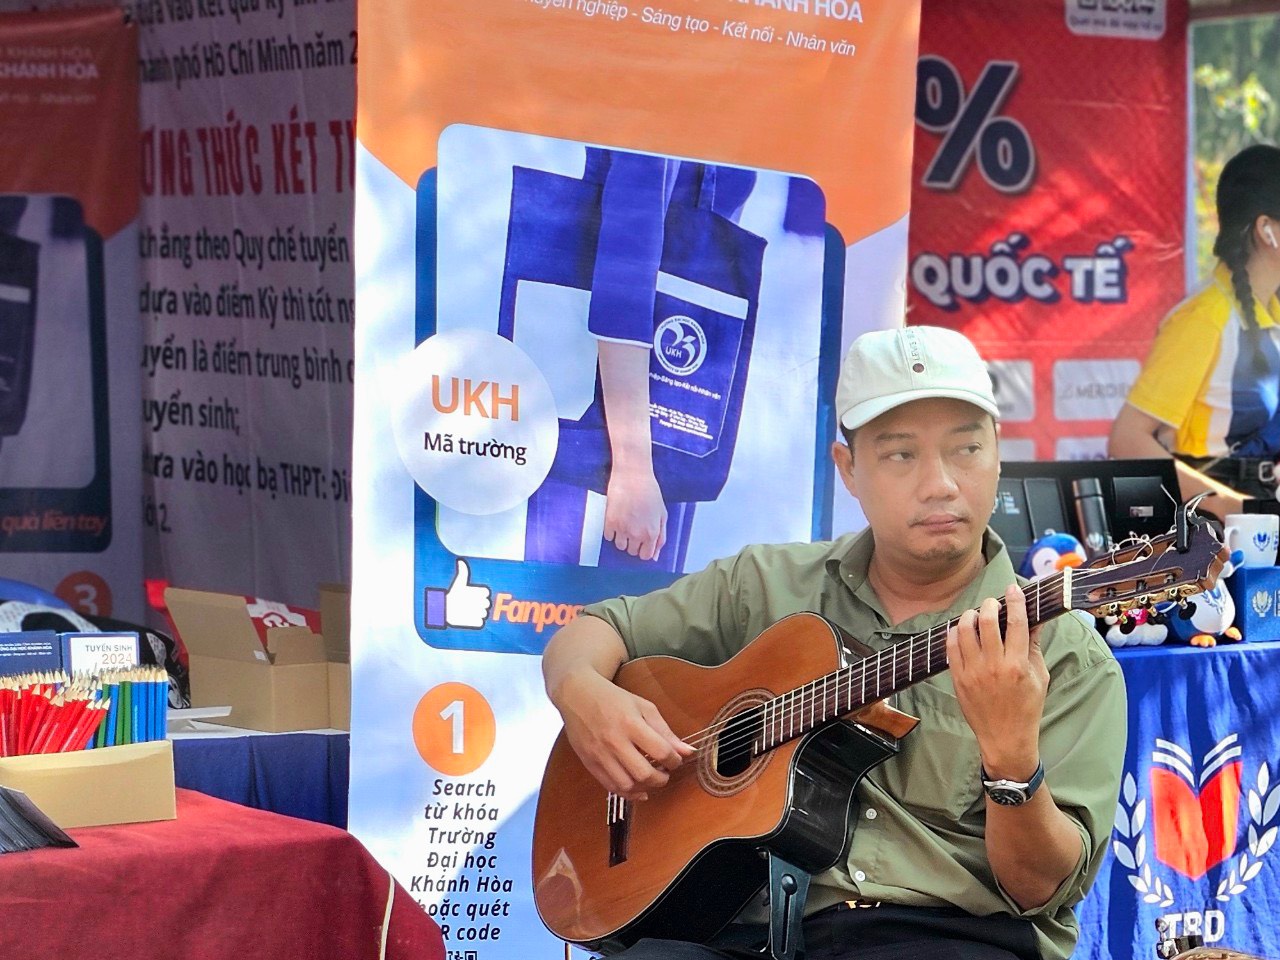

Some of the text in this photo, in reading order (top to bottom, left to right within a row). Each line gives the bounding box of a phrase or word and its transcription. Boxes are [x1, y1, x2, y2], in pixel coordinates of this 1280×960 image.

[576, 0, 628, 21] nghiệp
[641, 6, 681, 31] Sáng
[685, 16, 709, 33] tạo
[722, 19, 747, 39] Kết
[750, 25, 774, 43] nối
[786, 31, 826, 51] Nhân
[829, 40, 857, 57] văn
[204, 42, 226, 78] Hồ
[229, 38, 254, 75] Chí
[257, 34, 303, 73] Minh
[305, 31, 345, 69] năm
[196, 108, 263, 196] THỨC
[271, 104, 317, 195] KẾT
[195, 227, 231, 261] theo
[233, 228, 264, 271] Quy
[267, 225, 297, 262] chế
[300, 222, 350, 273] tuyển
[912, 232, 1135, 309] QUỐC TẾ
[182, 283, 212, 316] vào
[216, 280, 255, 319] điểm
[258, 285, 279, 329] Kỳ
[283, 287, 306, 321] thi
[308, 287, 335, 323] tốt
[192, 338, 209, 373] là
[213, 338, 252, 376] điểm
[256, 348, 303, 389] trung
[304, 346, 343, 384] bình
[665, 345, 683, 359] UKH
[431, 374, 520, 422] UKH
[199, 396, 240, 436] sinh;
[424, 431, 527, 466] Mã trường
[181, 450, 218, 484] vào
[223, 453, 251, 495] học
[256, 457, 278, 499] bạ
[280, 462, 327, 500] THPT:
[73, 584, 99, 618] 3
[101, 653, 133, 665] 2024
[113, 642, 133, 652] SINH
[439, 700, 465, 754] 1
[432, 779, 496, 797] Search
[424, 803, 498, 821] từ khóa
[429, 827, 497, 849] Trường
[427, 851, 497, 870] Đại học
[411, 875, 513, 893] Khánh Hòa
[466, 899, 510, 921] quét
[457, 923, 501, 941] code
